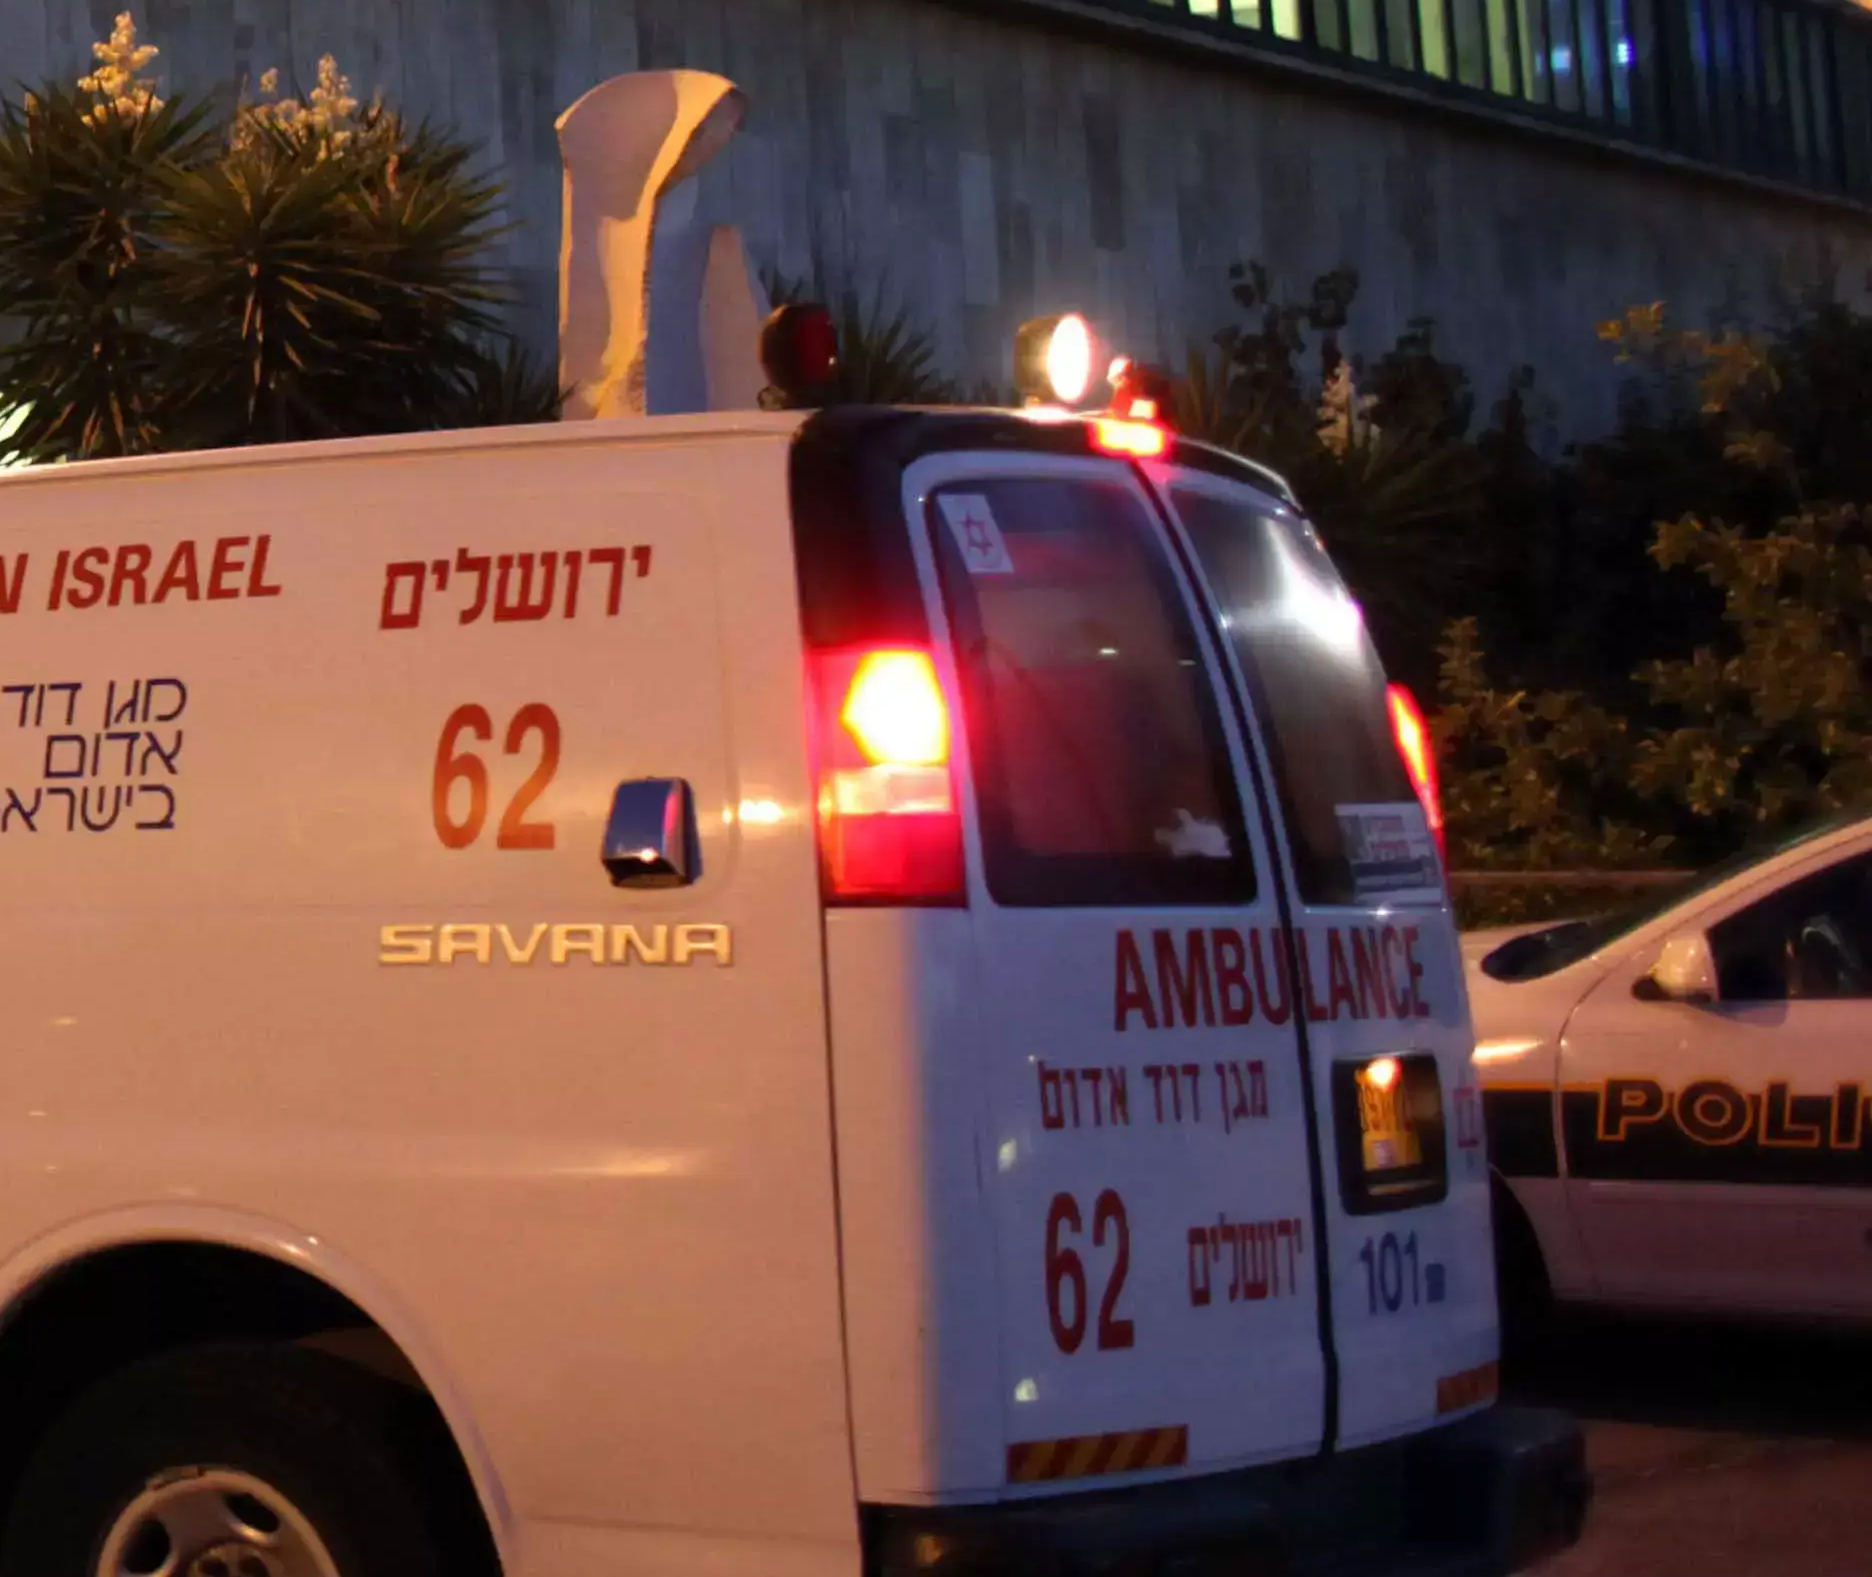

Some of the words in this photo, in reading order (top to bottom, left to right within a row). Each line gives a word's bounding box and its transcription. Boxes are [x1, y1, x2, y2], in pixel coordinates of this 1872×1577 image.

[46, 534, 282, 611] ISRAEL
[379, 545, 653, 630] ירושלים
[1, 682, 82, 727] דוד
[103, 678, 187, 730] מגן
[44, 729, 182, 779] אדום
[432, 702, 562, 851] 62
[378, 921, 736, 968] SAVANA
[1113, 924, 1430, 1032] AMBULANCE
[1038, 1061, 1129, 1129] אדום
[1143, 1063, 1200, 1124] דוד
[1214, 1060, 1270, 1135] מגן
[1597, 1076, 1872, 1151] POLI
[1045, 1188, 1135, 1354] 62
[1187, 1211, 1303, 1307] ירושלים
[1359, 1230, 1419, 1316] 101
